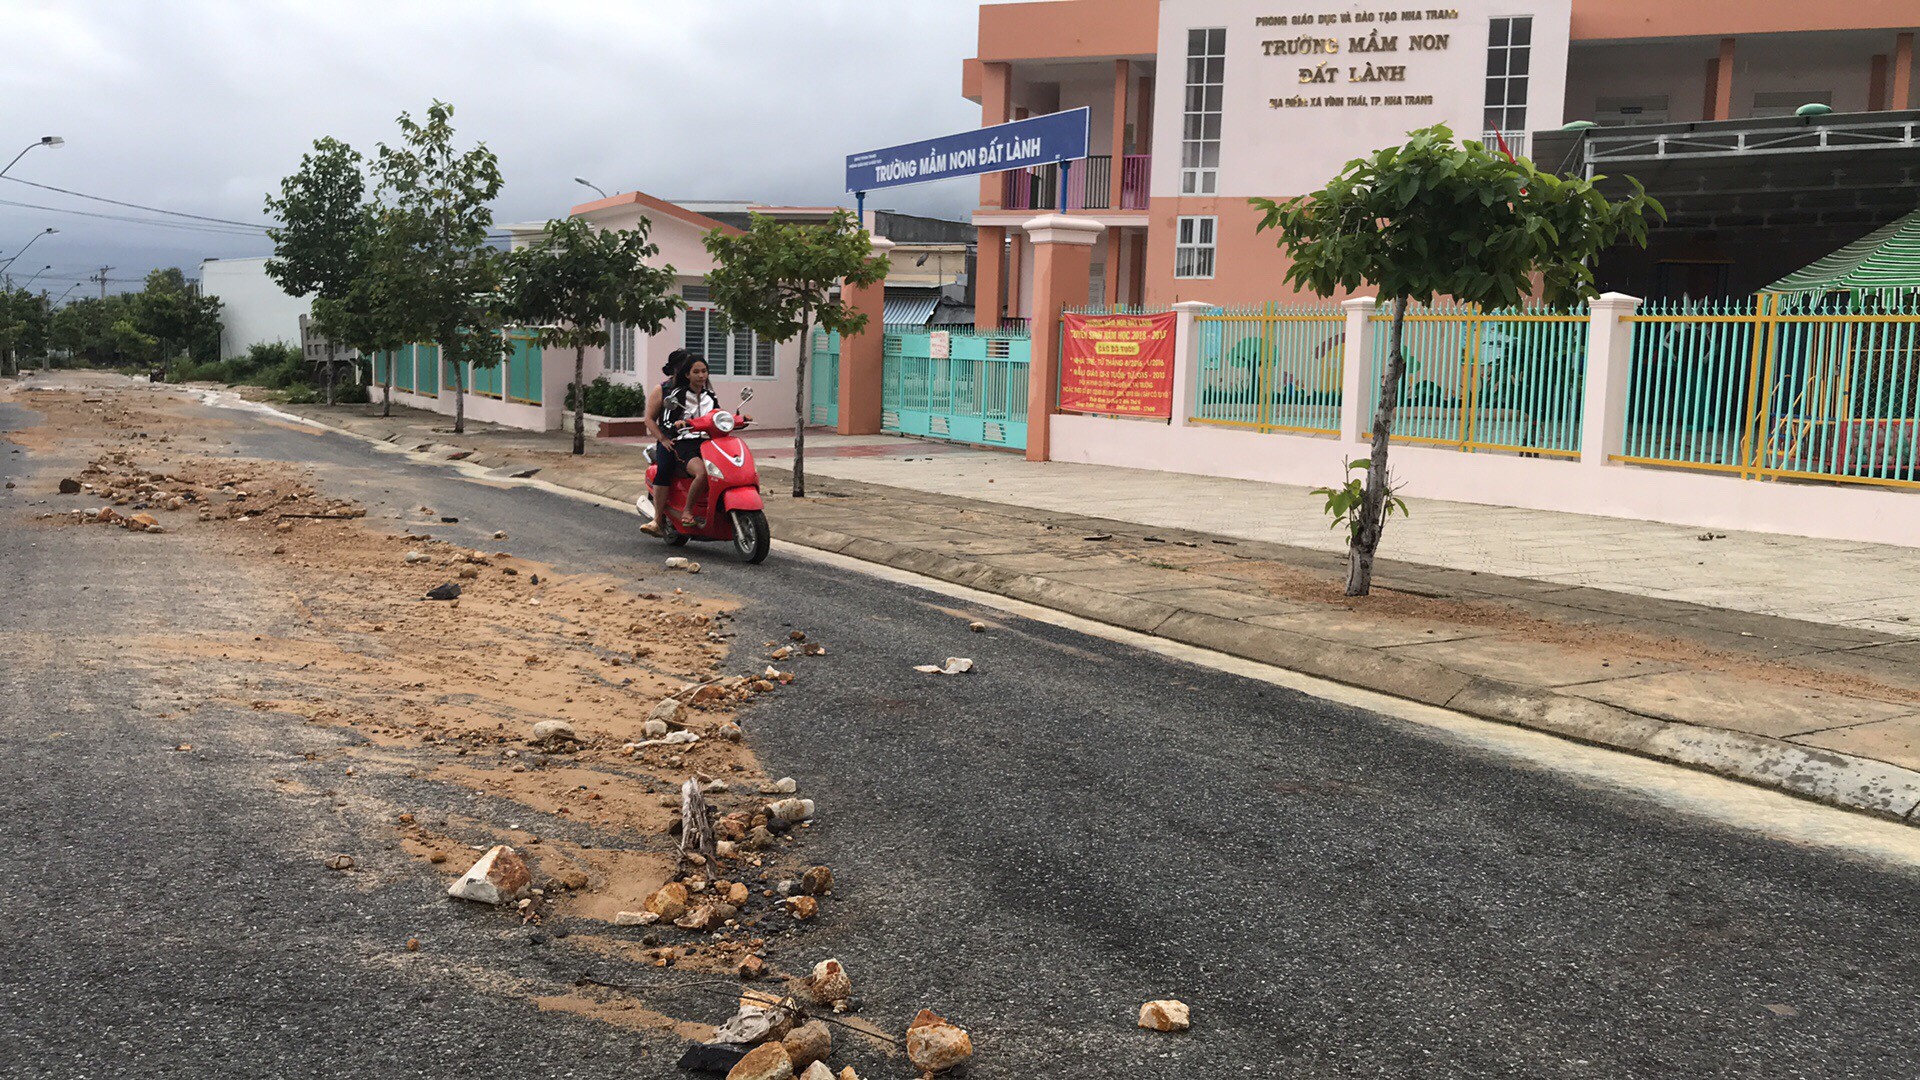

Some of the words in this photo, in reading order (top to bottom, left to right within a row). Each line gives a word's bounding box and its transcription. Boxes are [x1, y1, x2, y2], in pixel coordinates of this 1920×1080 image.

[1291, 13, 1314, 25] GIÁO
[1318, 14, 1337, 26] DỤC
[1340, 11, 1352, 23] VÀ
[1355, 11, 1375, 23] ĐÀO
[1378, 11, 1397, 24] TẠO
[1401, 11, 1422, 21] NHA
[1425, 9, 1459, 20] TRANG
[1261, 33, 1339, 56] TRƯỜNG
[1348, 28, 1398, 53] MẦM
[1408, 34, 1450, 51] NON
[1298, 61, 1339, 84] ĐẤT
[1348, 61, 1406, 83] LÀNH
[1384, 96, 1402, 106] NHA
[1404, 95, 1434, 105] TRANG
[875, 158, 917, 183] TRƯỜNG
[919, 147, 946, 176] MẦM
[949, 148, 976, 171] NON
[979, 136, 1003, 166] ĐẤT
[1006, 135, 1041, 161] LÀNH
